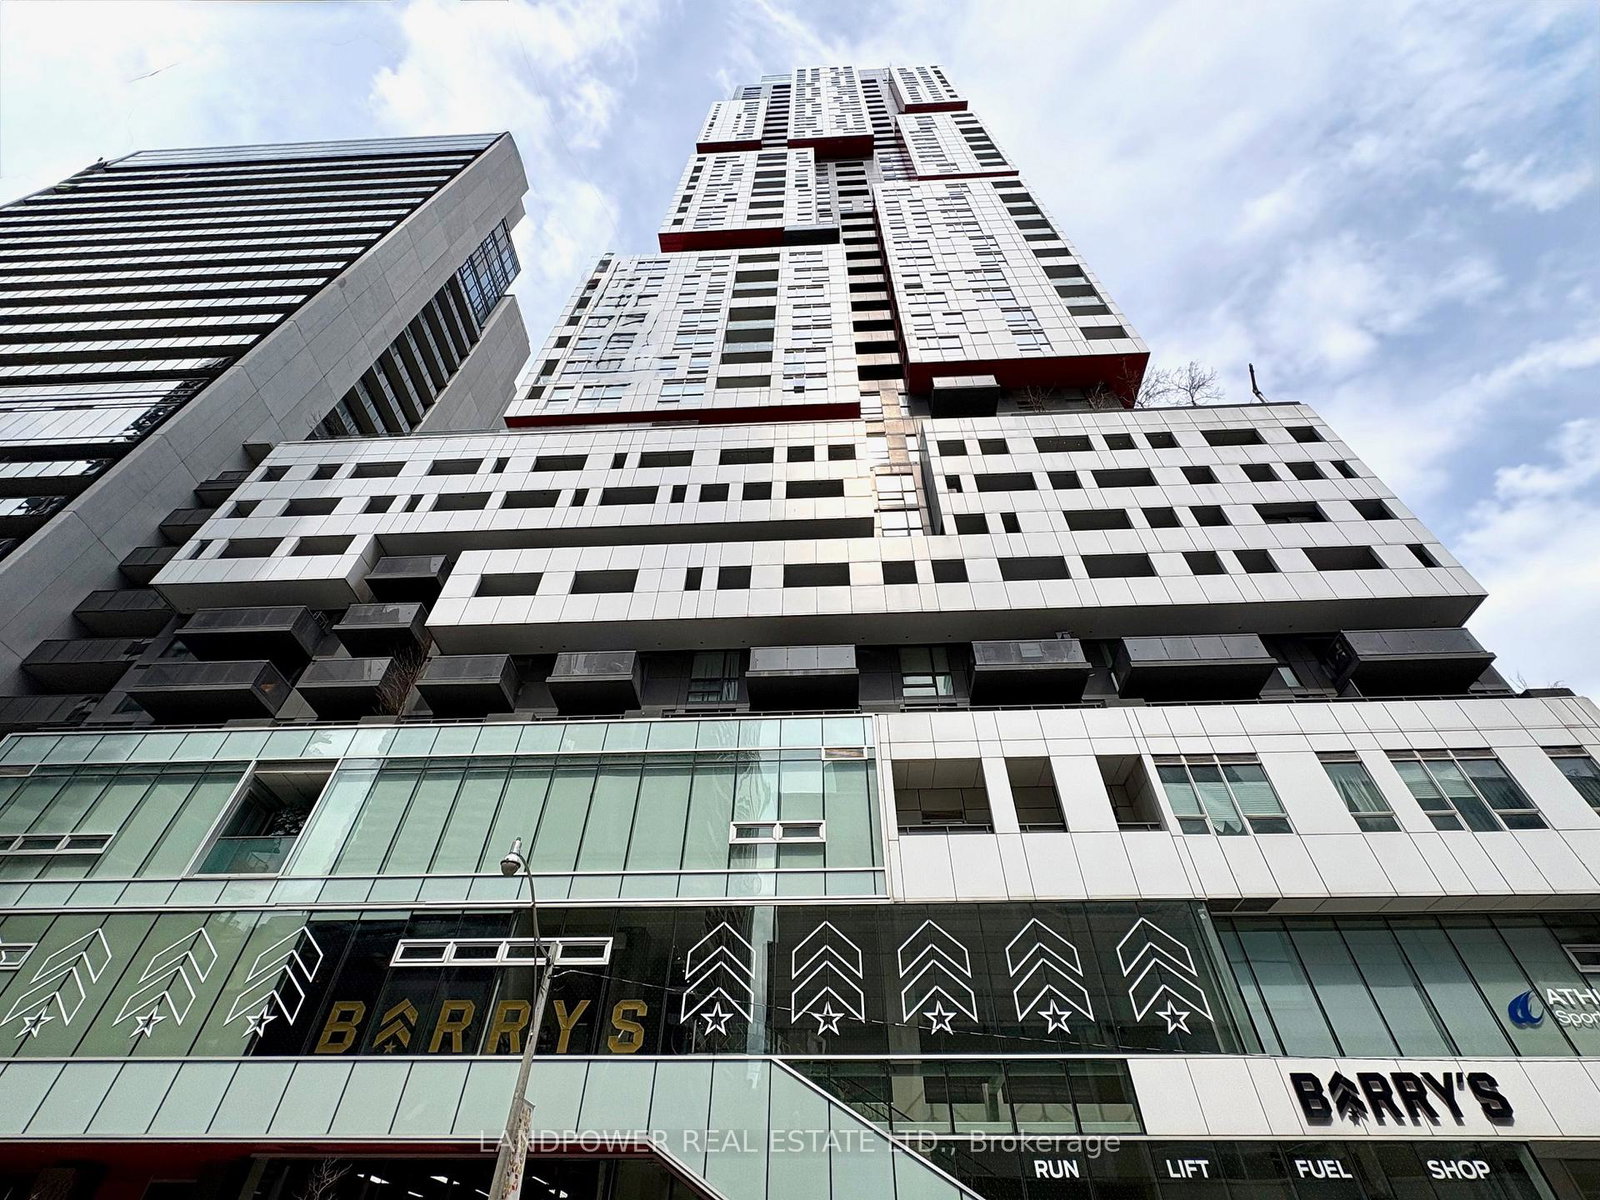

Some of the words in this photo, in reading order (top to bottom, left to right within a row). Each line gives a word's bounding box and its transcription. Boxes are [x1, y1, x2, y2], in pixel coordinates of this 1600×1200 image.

[1546, 988, 1600, 1005] ATH
[1290, 1071, 1514, 1122] BARRY'S
[1034, 1160, 1080, 1179] RUN
[1166, 1160, 1209, 1178] LIFT
[1295, 1160, 1353, 1179] FUEL
[1426, 1159, 1491, 1180] SHOP
